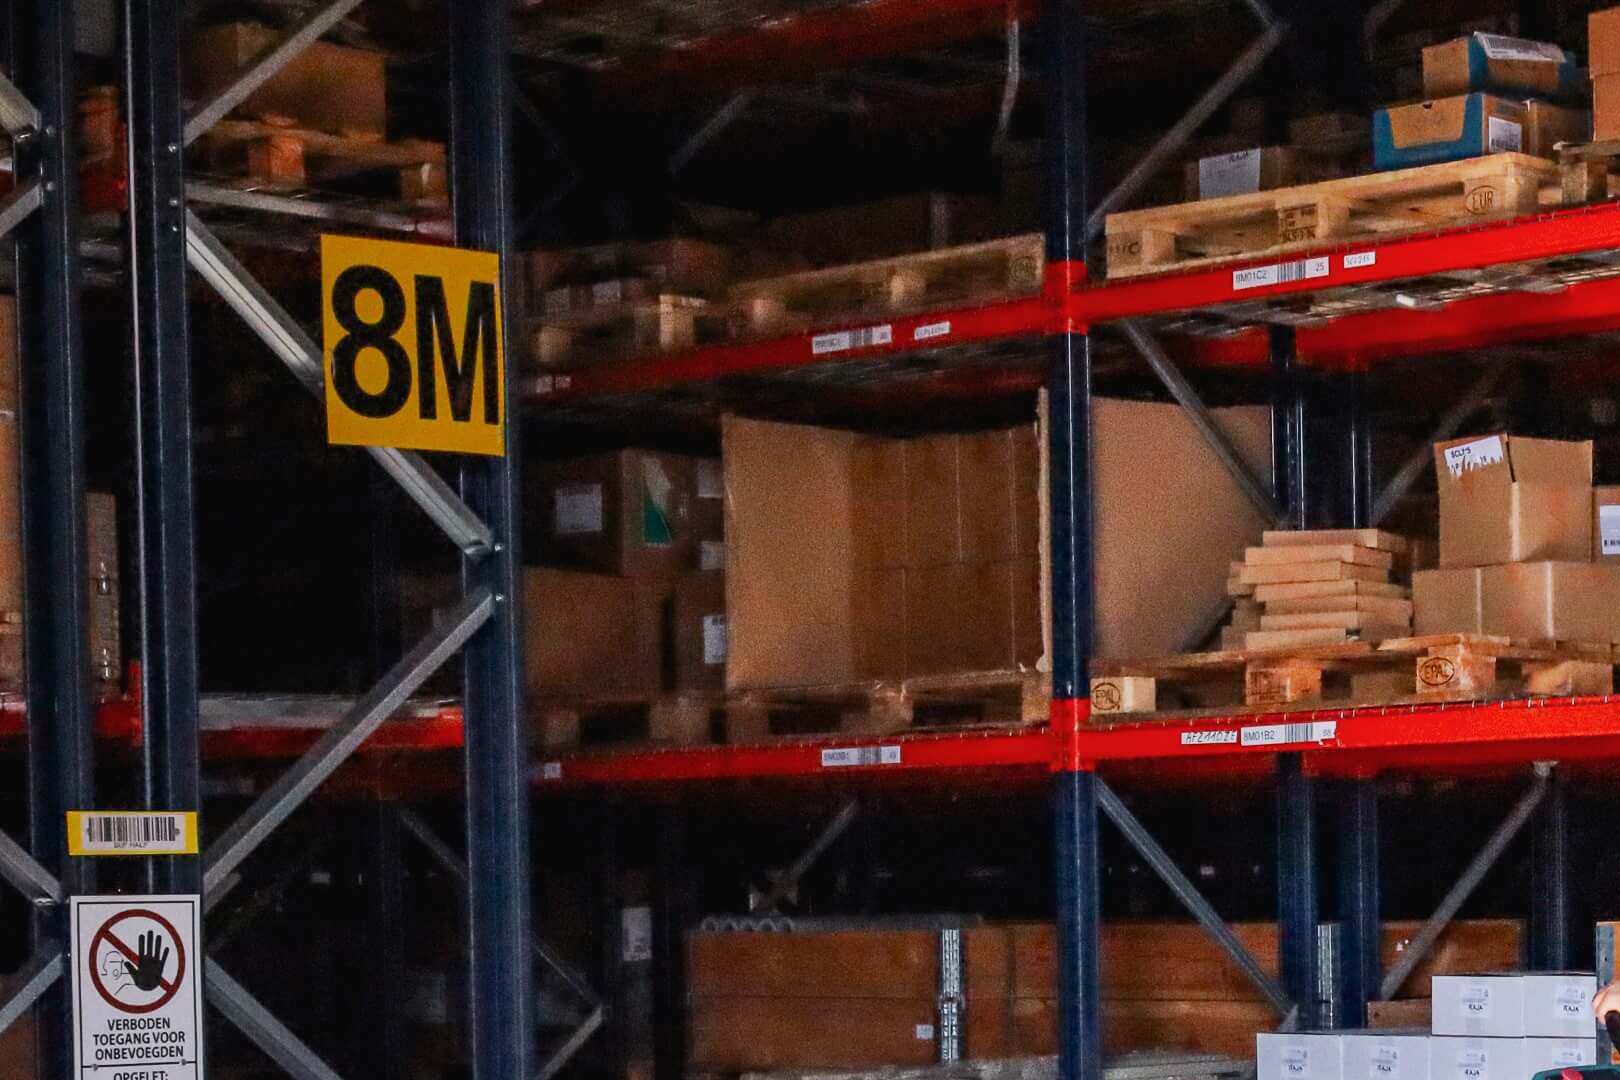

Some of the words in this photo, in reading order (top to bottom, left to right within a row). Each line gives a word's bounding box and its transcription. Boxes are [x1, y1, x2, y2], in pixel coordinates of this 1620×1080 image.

[332, 264, 499, 425] 8M
[1468, 1004, 1484, 1012] RAJA
[1563, 1004, 1580, 1013] RAJA
[107, 1017, 171, 1031] VERBODEN
[93, 1032, 151, 1046] TOEGANG
[152, 1031, 185, 1044] VOOR
[95, 1045, 184, 1061] ONBEVOEGDEN
